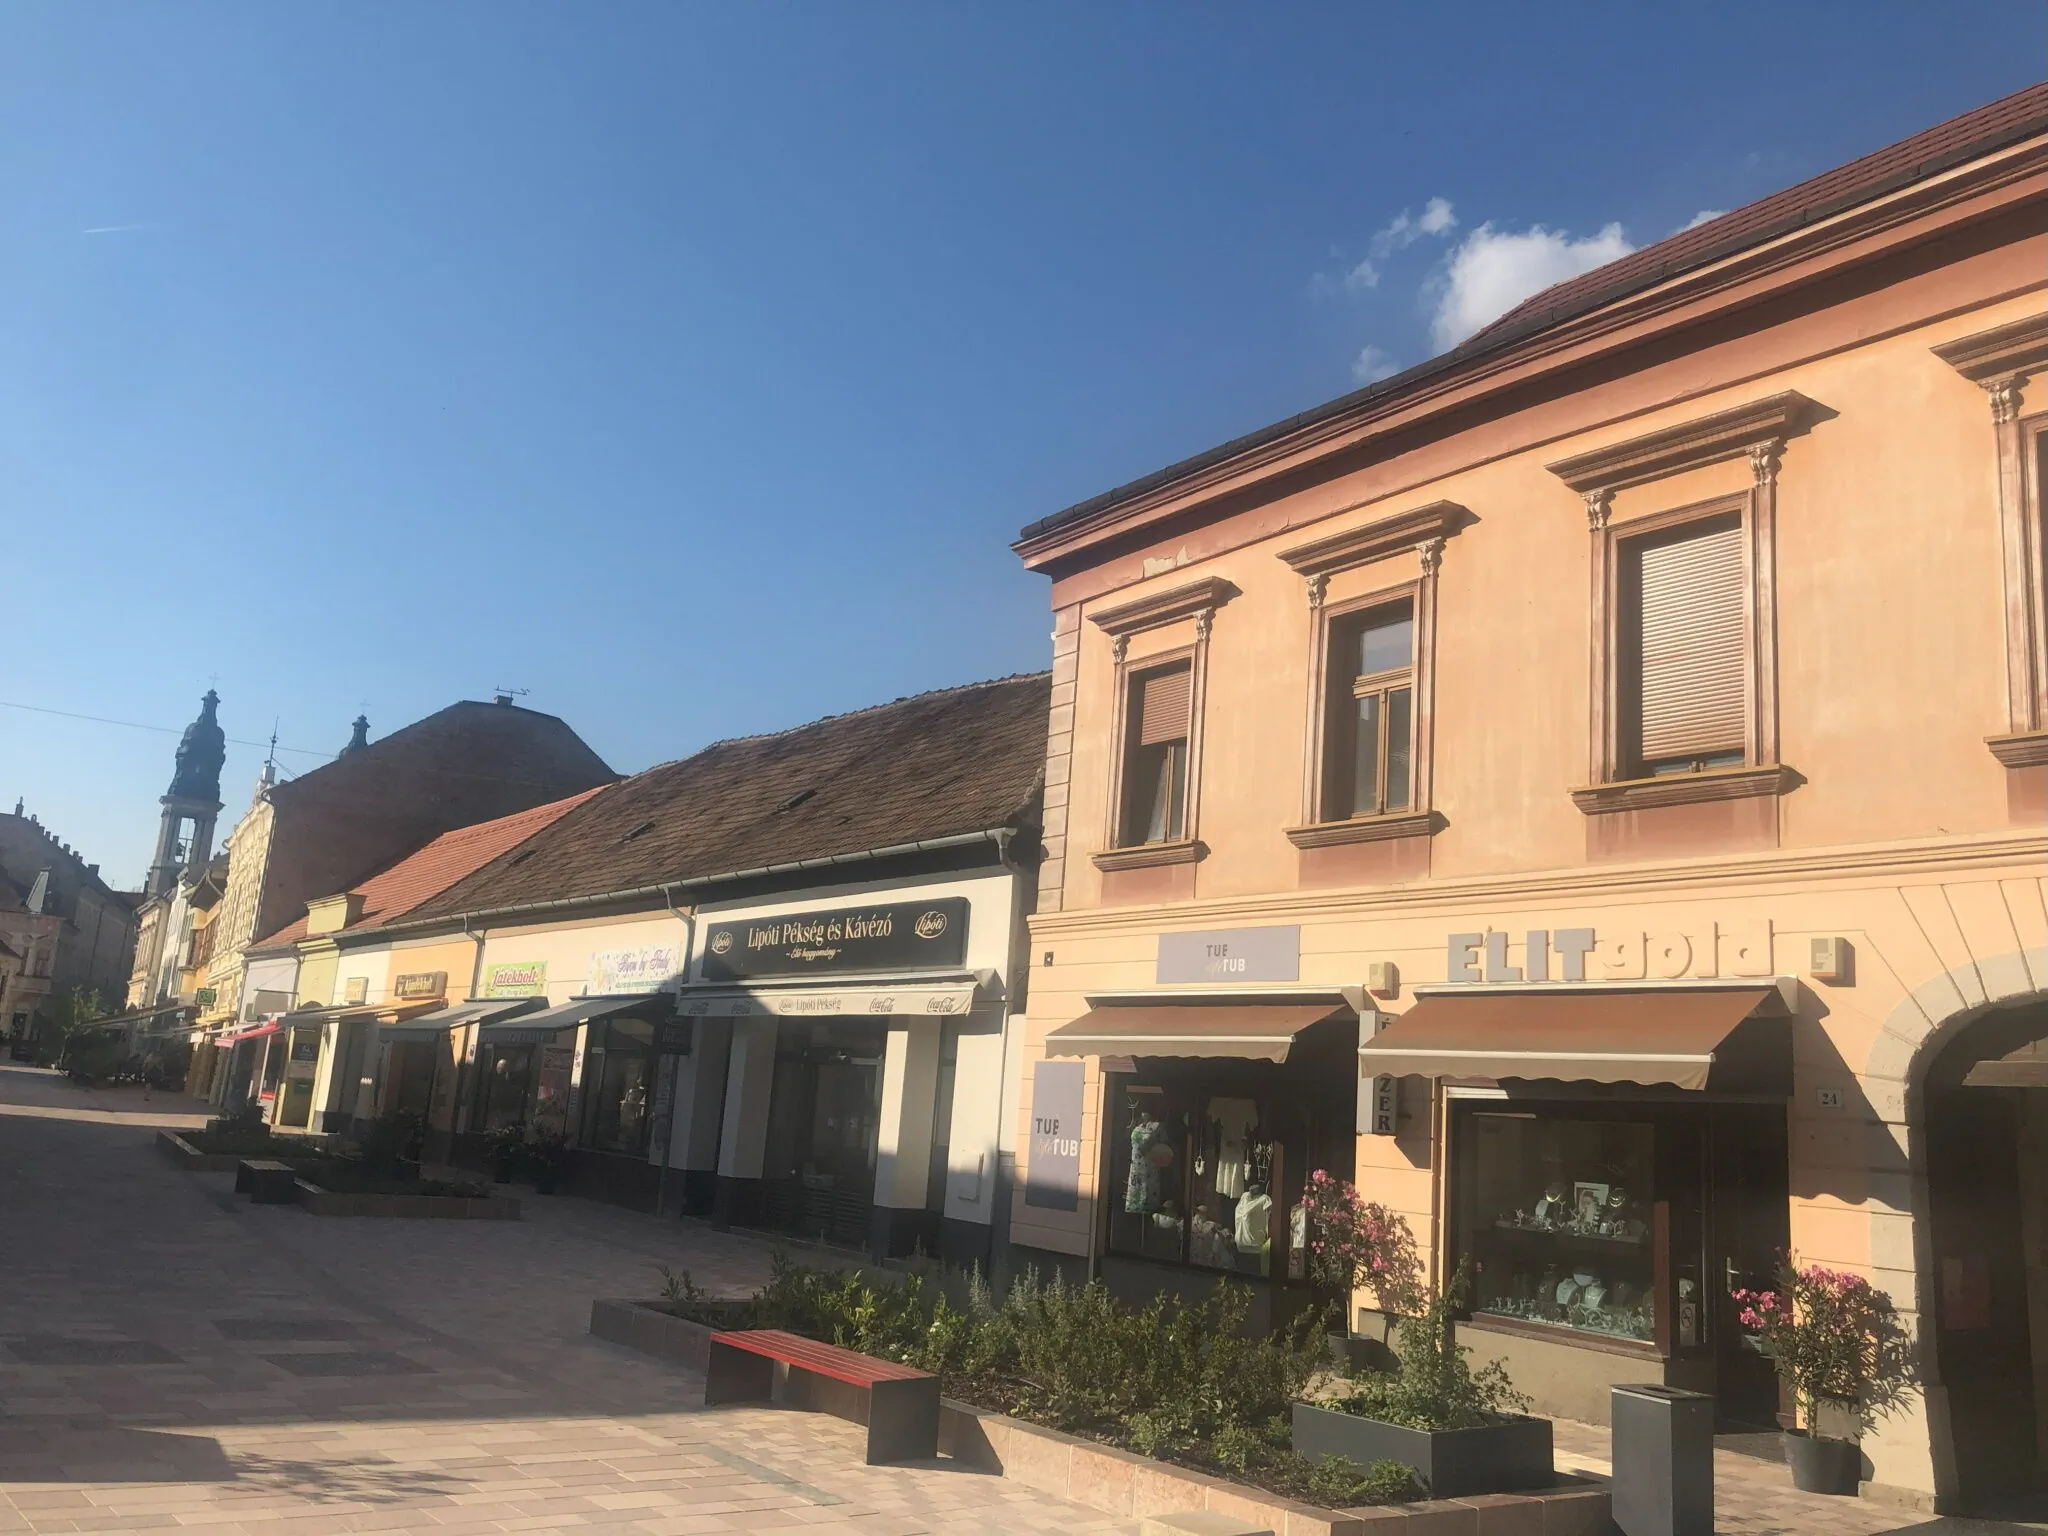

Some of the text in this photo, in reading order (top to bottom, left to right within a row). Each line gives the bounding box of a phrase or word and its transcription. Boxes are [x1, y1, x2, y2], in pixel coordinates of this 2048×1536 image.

[748, 912, 892, 950] Lipóti Pékség és Kávézó
[1223, 958, 1246, 973] TUB
[1052, 1138, 1078, 1157] TUB
